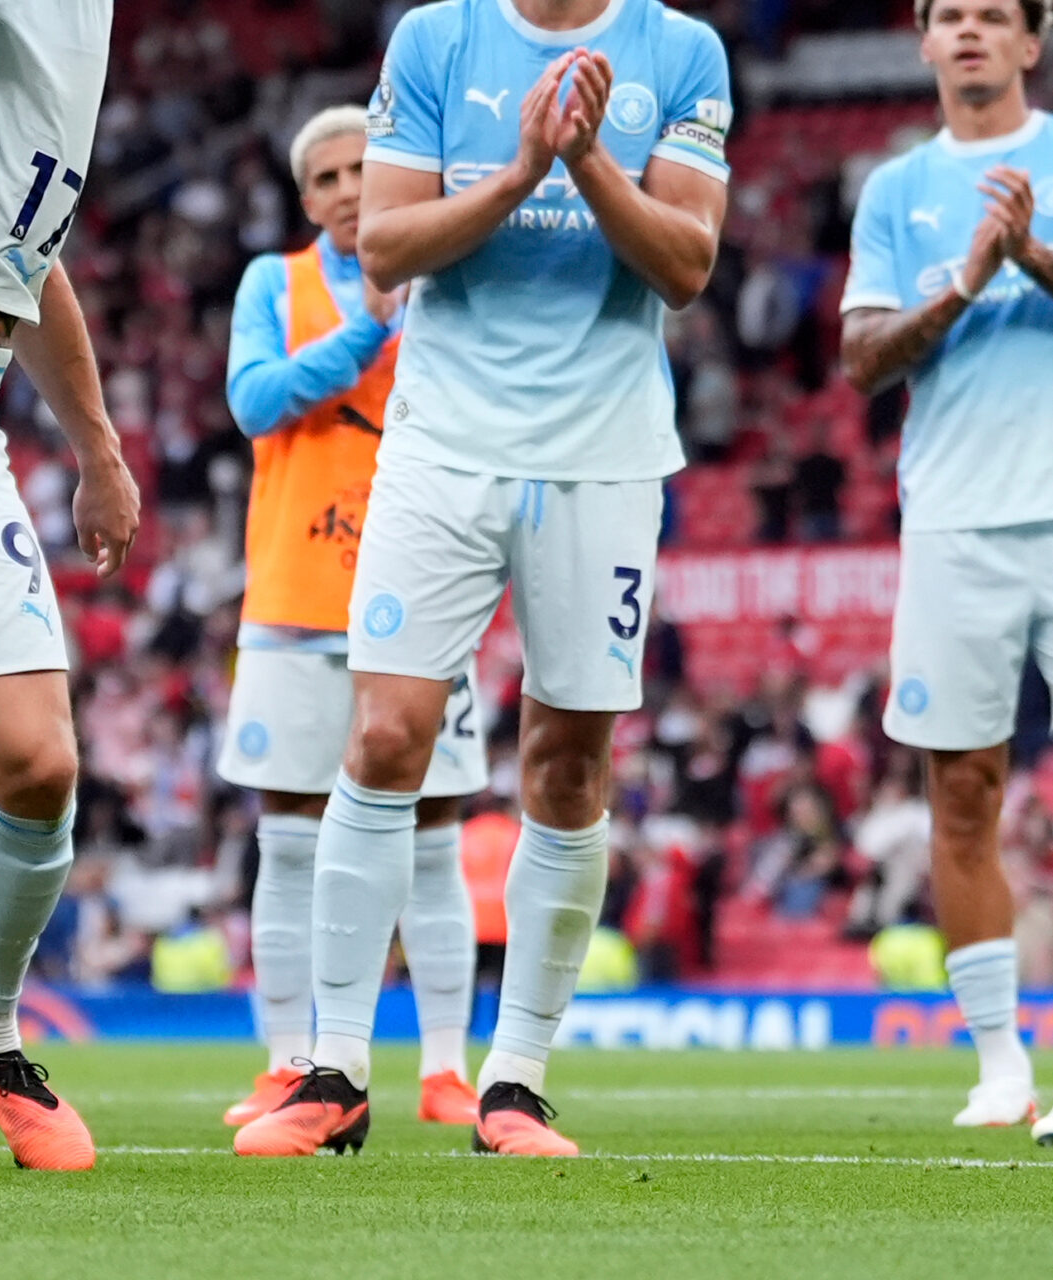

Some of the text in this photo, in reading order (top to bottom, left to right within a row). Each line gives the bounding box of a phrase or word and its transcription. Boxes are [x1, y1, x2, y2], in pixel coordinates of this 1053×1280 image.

[674, 123, 724, 149] Capta
[10, 150, 83, 257] 17
[499, 208, 596, 231] IRWAY
[1, 521, 41, 594] 9
[608, 566, 642, 640] 3
[442, 672, 474, 737] 2
